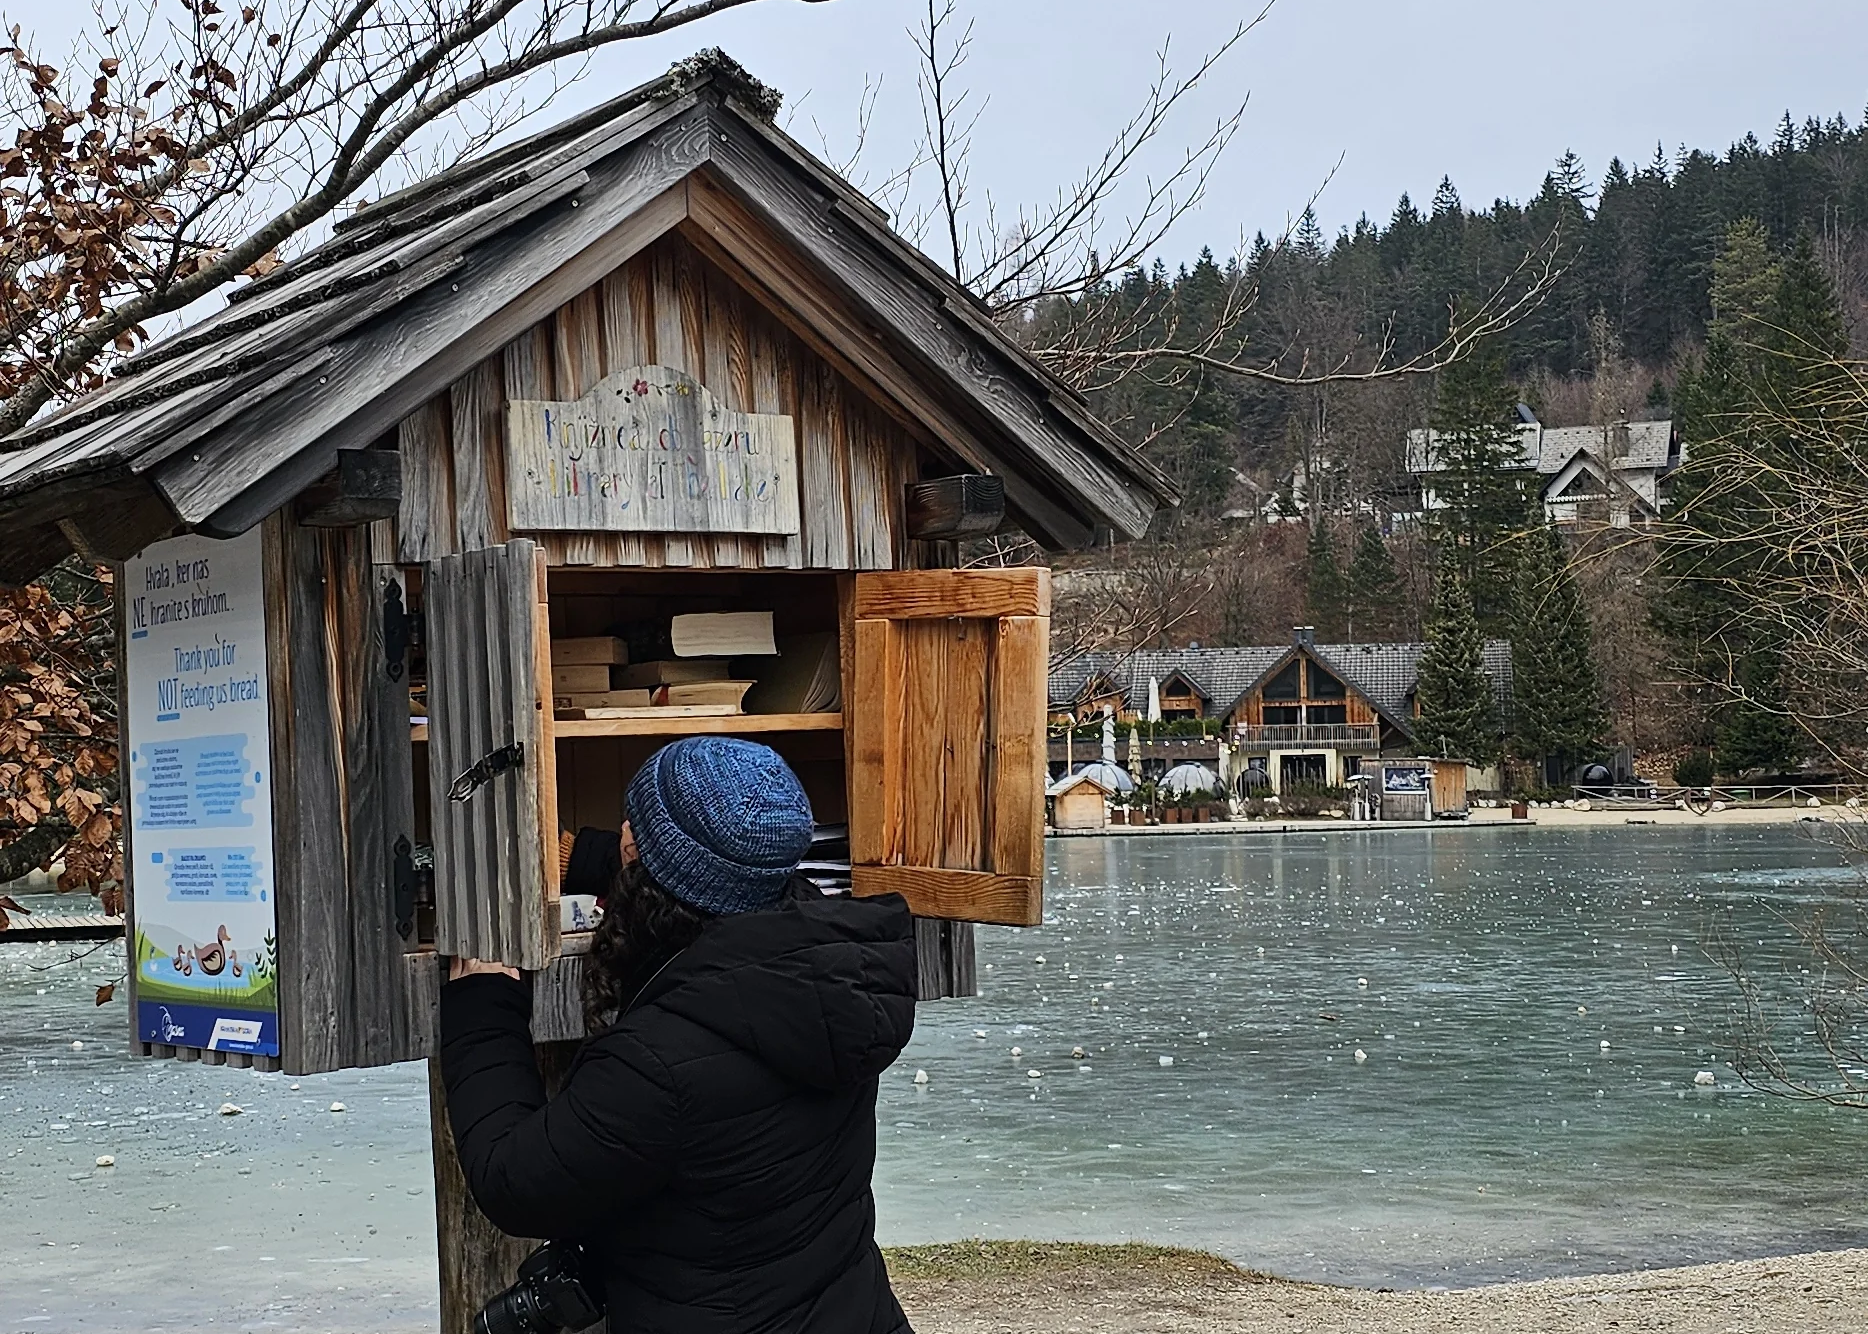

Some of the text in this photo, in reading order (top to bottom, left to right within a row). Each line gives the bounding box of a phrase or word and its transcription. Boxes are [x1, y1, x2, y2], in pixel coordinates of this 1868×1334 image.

[175, 559, 191, 585] ker
[192, 558, 210, 583] nas
[133, 597, 148, 629] NE
[150, 599, 183, 626] hranite
[184, 599, 189, 620] s
[174, 639, 237, 675] Thank you for
[158, 678, 179, 712] NOT
[180, 681, 215, 711] feeding
[216, 682, 228, 704] us
